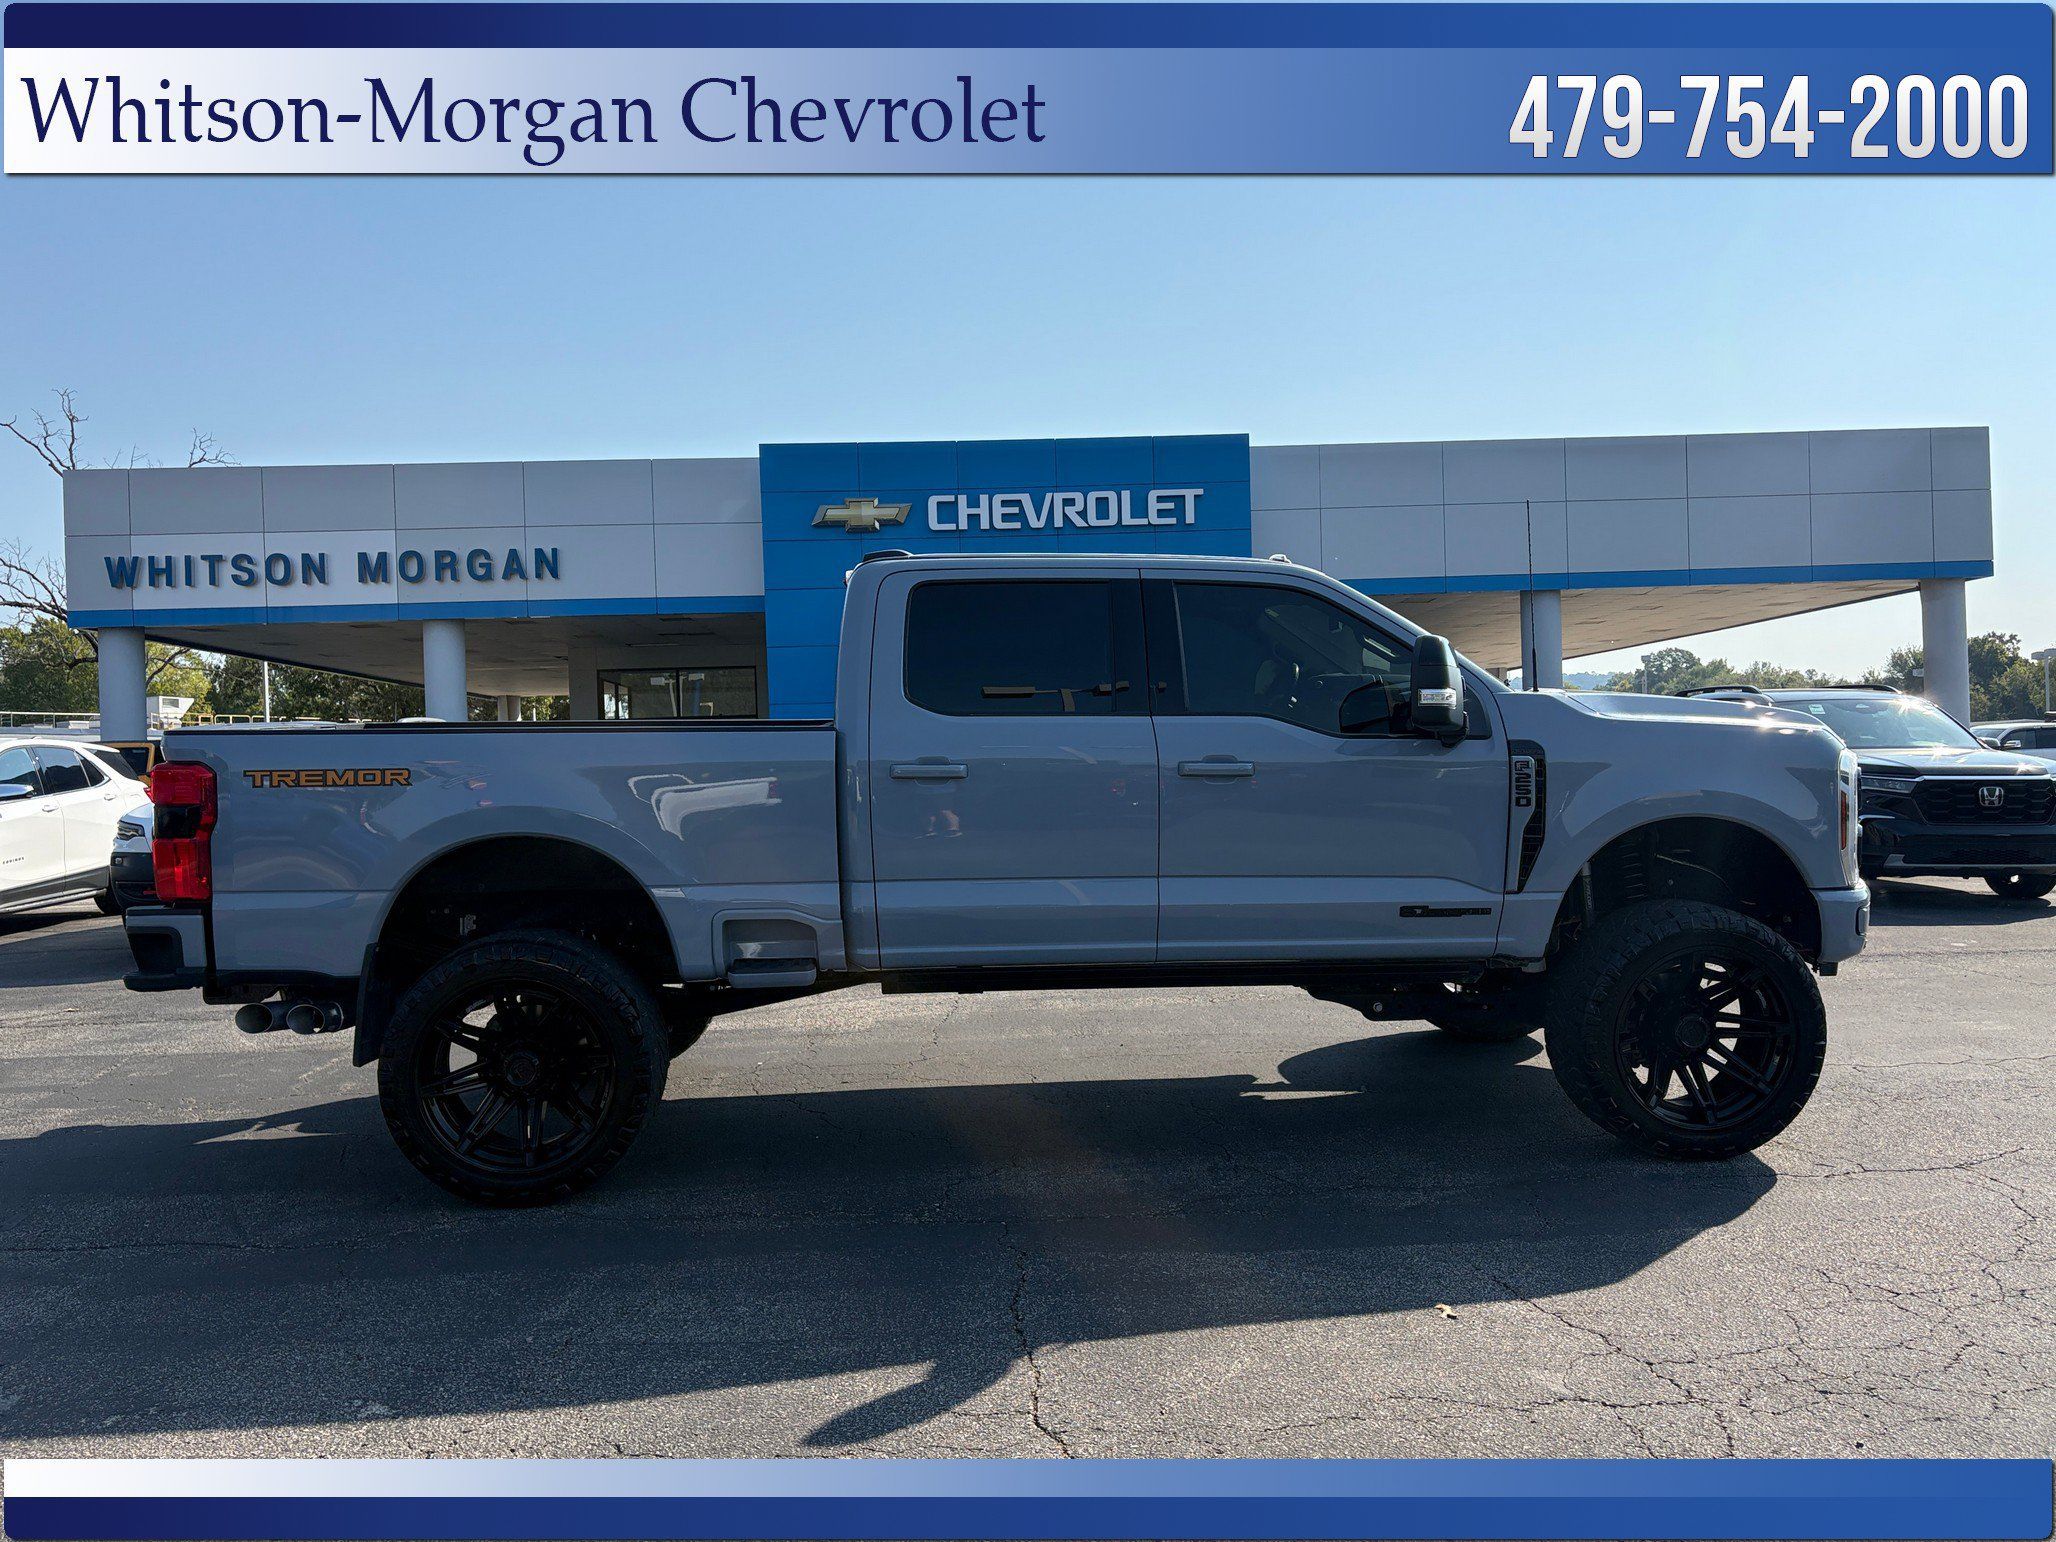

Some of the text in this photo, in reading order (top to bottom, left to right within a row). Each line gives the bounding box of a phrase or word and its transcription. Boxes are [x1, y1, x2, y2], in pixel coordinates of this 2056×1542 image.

[927, 488, 1204, 531] CHEVROLET
[104, 547, 561, 589] WHITSON MORGAN
[243, 768, 412, 788] TREMOR
